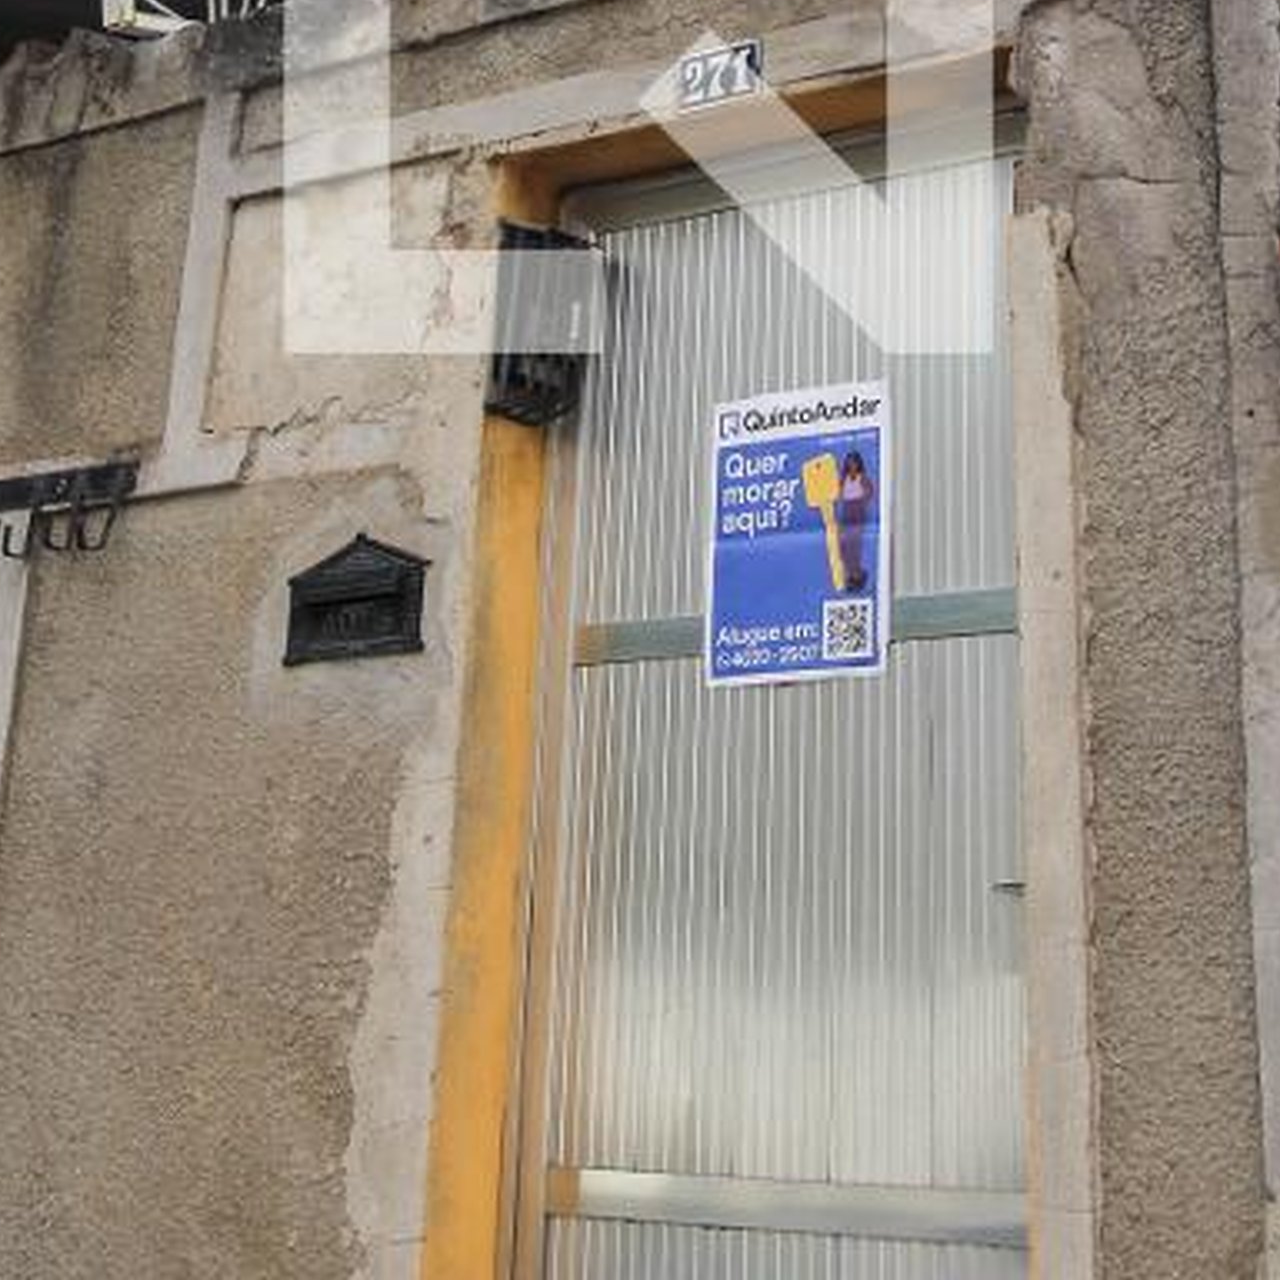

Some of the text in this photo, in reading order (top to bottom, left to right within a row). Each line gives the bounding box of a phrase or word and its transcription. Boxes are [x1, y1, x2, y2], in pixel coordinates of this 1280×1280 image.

[743, 395, 881, 432] QuintoAndar
[725, 453, 789, 479] Quer
[723, 479, 800, 507] morar
[722, 500, 792, 538] aqui?
